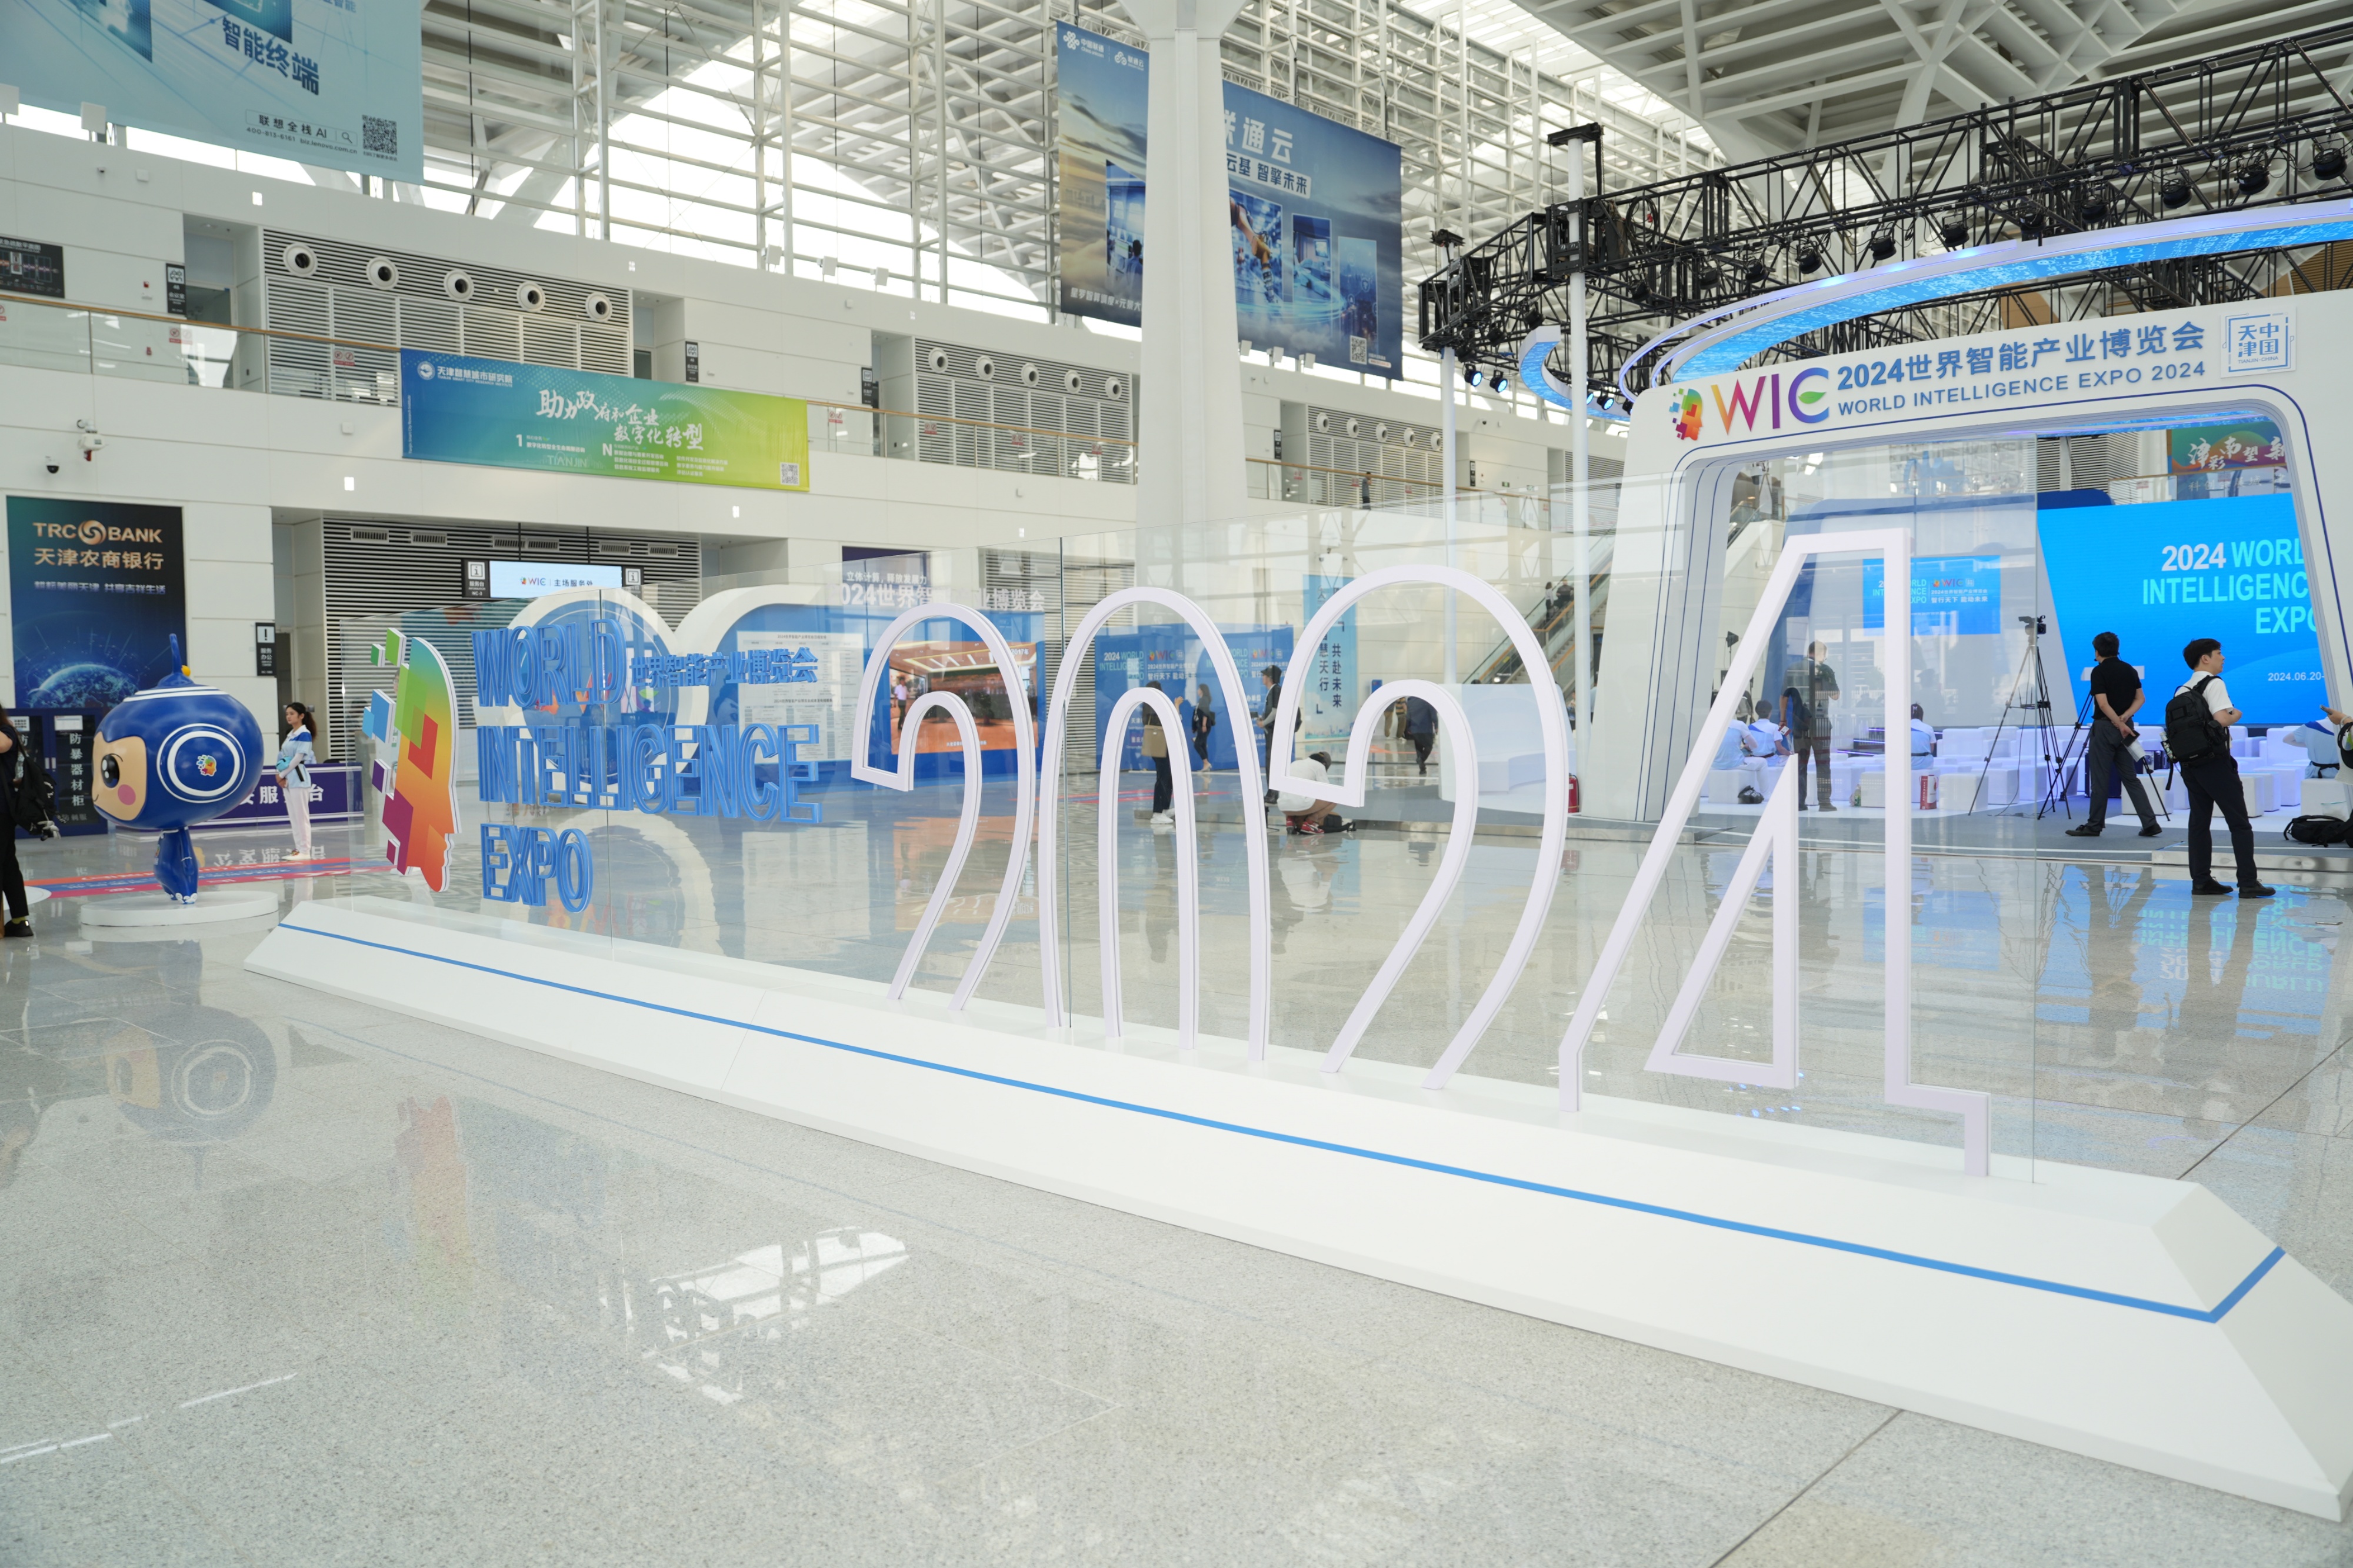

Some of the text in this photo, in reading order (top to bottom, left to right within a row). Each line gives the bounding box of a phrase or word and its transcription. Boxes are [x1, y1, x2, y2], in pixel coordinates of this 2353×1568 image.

[222, 16, 319, 95] 智能终端
[1081, 38, 1104, 53] 中国联通
[1127, 55, 1144, 68] 联通云
[259, 114, 326, 138] 联想全栈 AI
[300, 139, 357, 154] biz.lenovo.com.cn
[1258, 162, 1307, 195] 智擎未来
[1837, 321, 2206, 391] 2024世界智能产业博览会
[437, 366, 513, 383] 天津智慧城市研究院
[1838, 361, 2205, 415] WORLD INTELLIGENCE EXPO 2024
[536, 389, 659, 426] 助力政府和企业
[516, 434, 522, 447] 1
[602, 443, 612, 456] N
[614, 423, 704, 451] 数字化转型
[547, 455, 587, 468] TIANJIN
[32, 522, 163, 543] TRC BANK
[34, 548, 164, 569] 天津农商银行
[2161, 538, 2305, 572] 2024 WORL
[104, 583, 165, 595] 共享吉祥生活
[2142, 573, 2309, 605] INTELLIGENC
[471, 619, 626, 708] WORLD
[629, 646, 818, 688] 世界智能产业博览会
[1099, 661, 1144, 671] INTELLIGENCE
[1104, 651, 1144, 661] 2024 WORLD
[1332, 643, 1342, 708] 共赴未来
[69, 733, 85, 807] 防暴器材柜
[476, 723, 823, 823] INTELLIGENCE
[850, 527, 1992, 1177] 2024
[481, 823, 594, 913] EXPO
